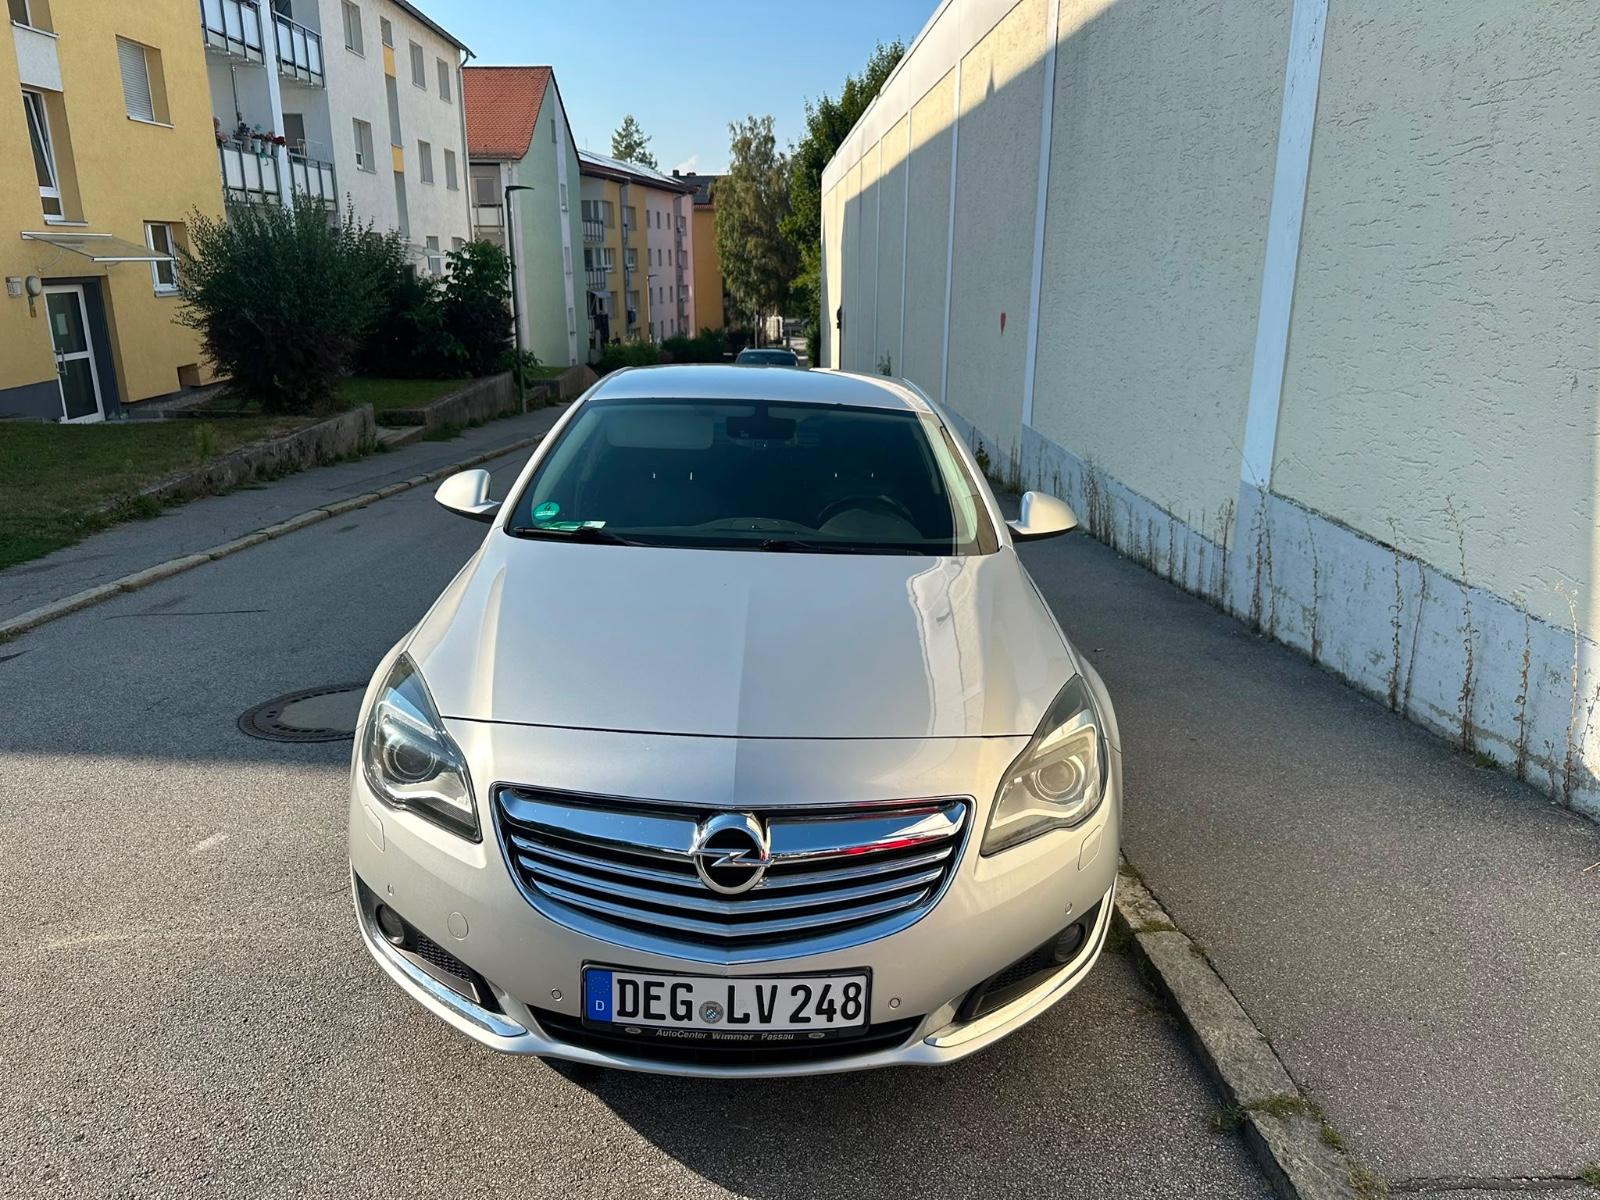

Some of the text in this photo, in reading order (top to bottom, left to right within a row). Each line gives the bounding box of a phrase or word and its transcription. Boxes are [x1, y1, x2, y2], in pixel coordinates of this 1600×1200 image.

[595, 999, 605, 1011] D
[616, 978, 863, 1024] DEG LV 248
[655, 1029, 795, 1041] AutoCenter Wimmer Passau
